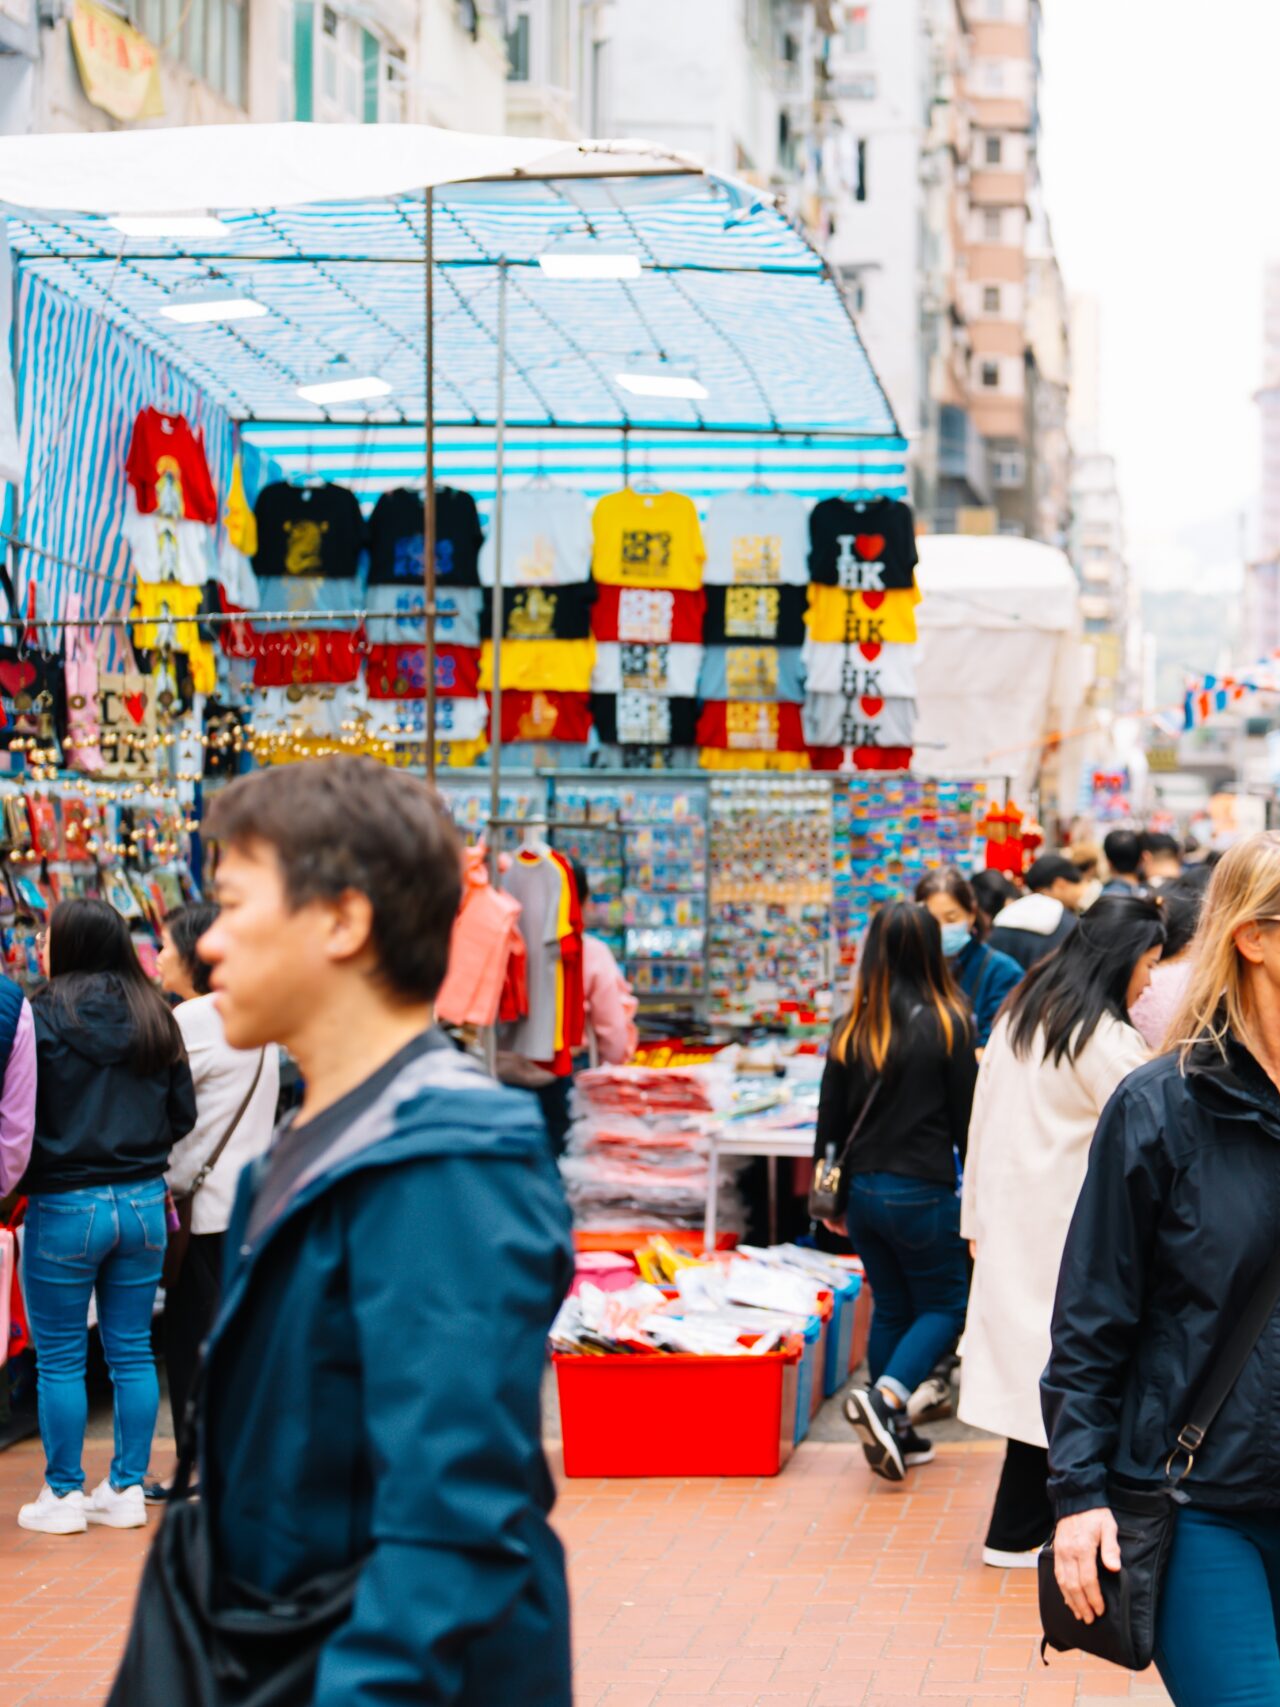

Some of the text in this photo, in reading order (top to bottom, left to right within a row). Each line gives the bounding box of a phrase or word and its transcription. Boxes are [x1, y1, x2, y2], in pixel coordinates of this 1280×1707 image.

[836, 534, 857, 559] I
[837, 557, 885, 591] HK
[842, 618, 884, 643] HK
[841, 670, 881, 694] HK
[840, 723, 881, 746] HK
